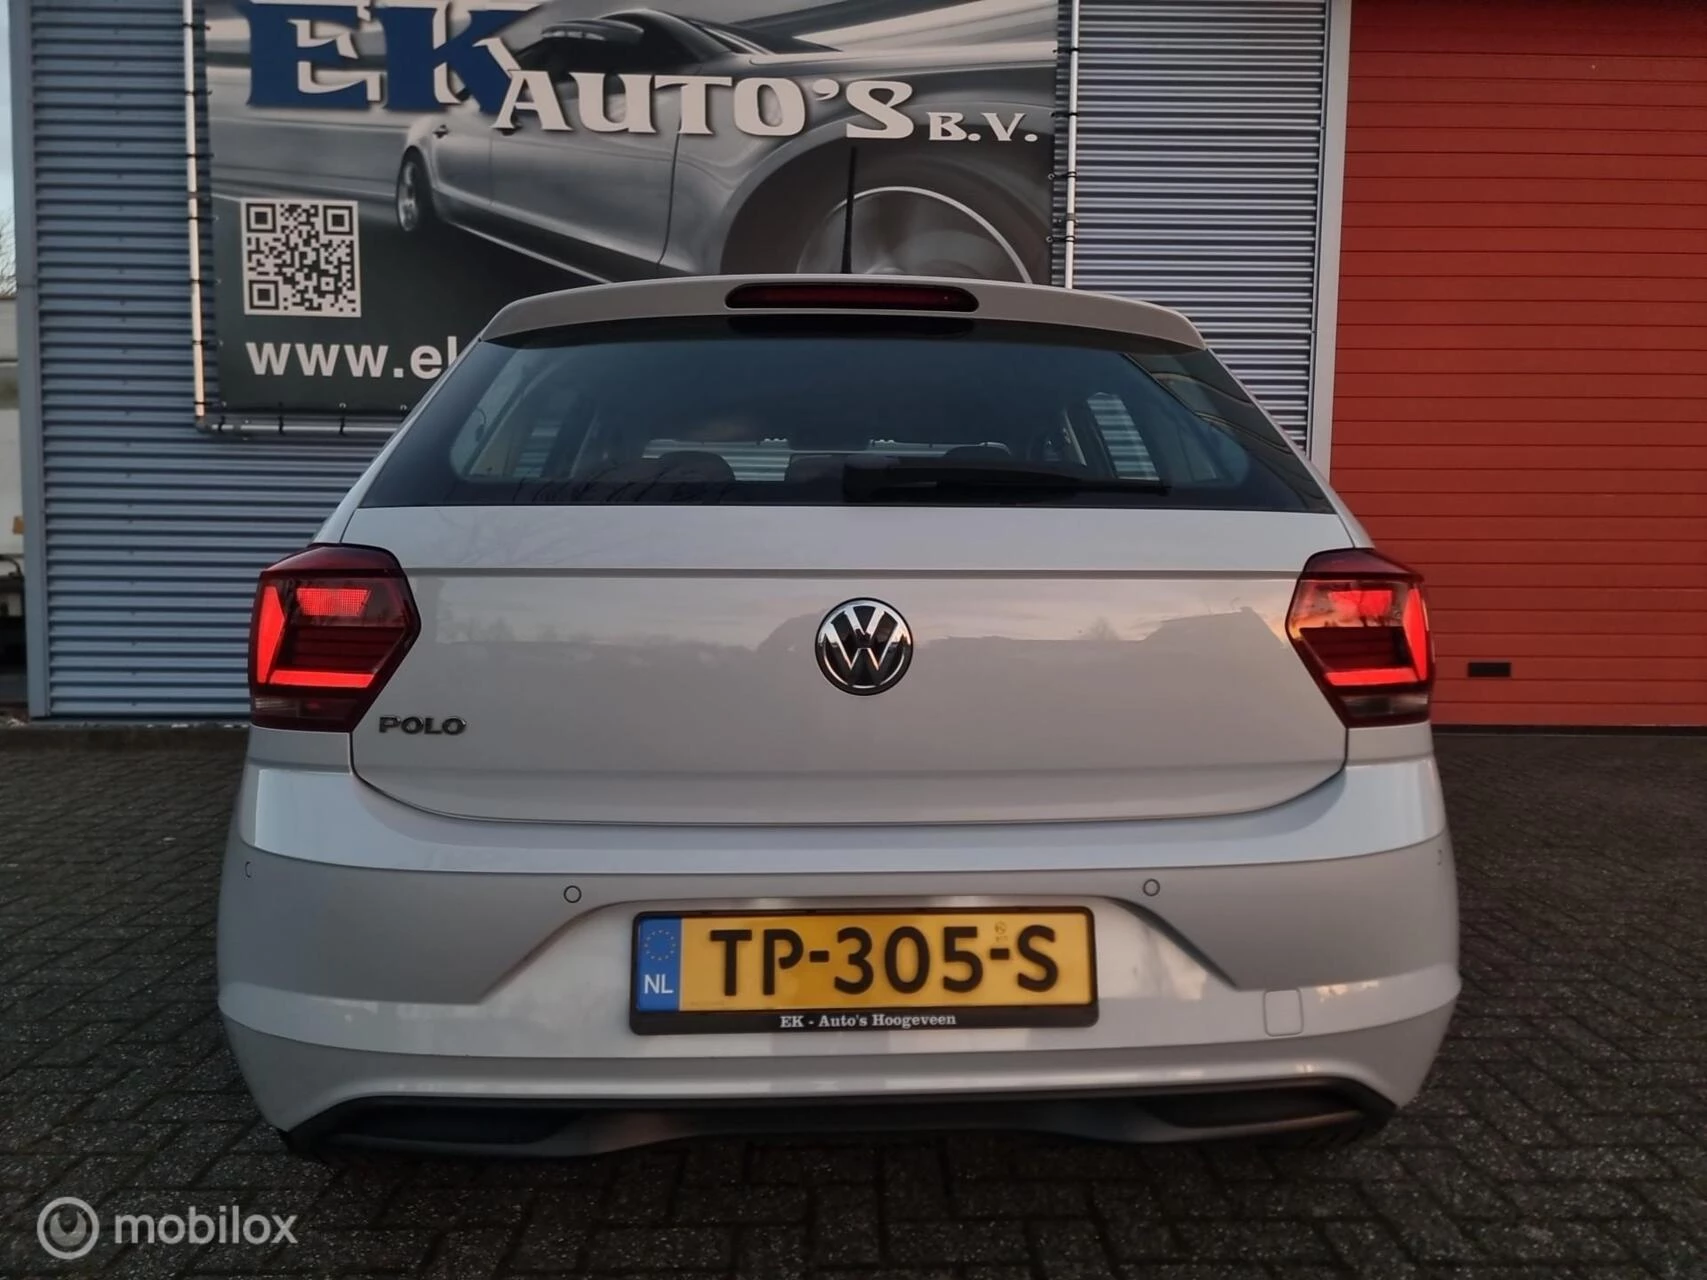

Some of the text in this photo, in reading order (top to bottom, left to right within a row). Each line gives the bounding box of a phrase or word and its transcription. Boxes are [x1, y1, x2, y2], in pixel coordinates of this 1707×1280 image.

[238, 3, 1038, 142] EK AUTO'S B.V.
[378, 716, 467, 736] POLO
[710, 924, 1059, 996] TP-305-S
[644, 974, 674, 995] NL
[780, 1015, 805, 1029] EK
[818, 1014, 868, 1028] Auto's
[871, 1013, 957, 1030] Hoogeveen
